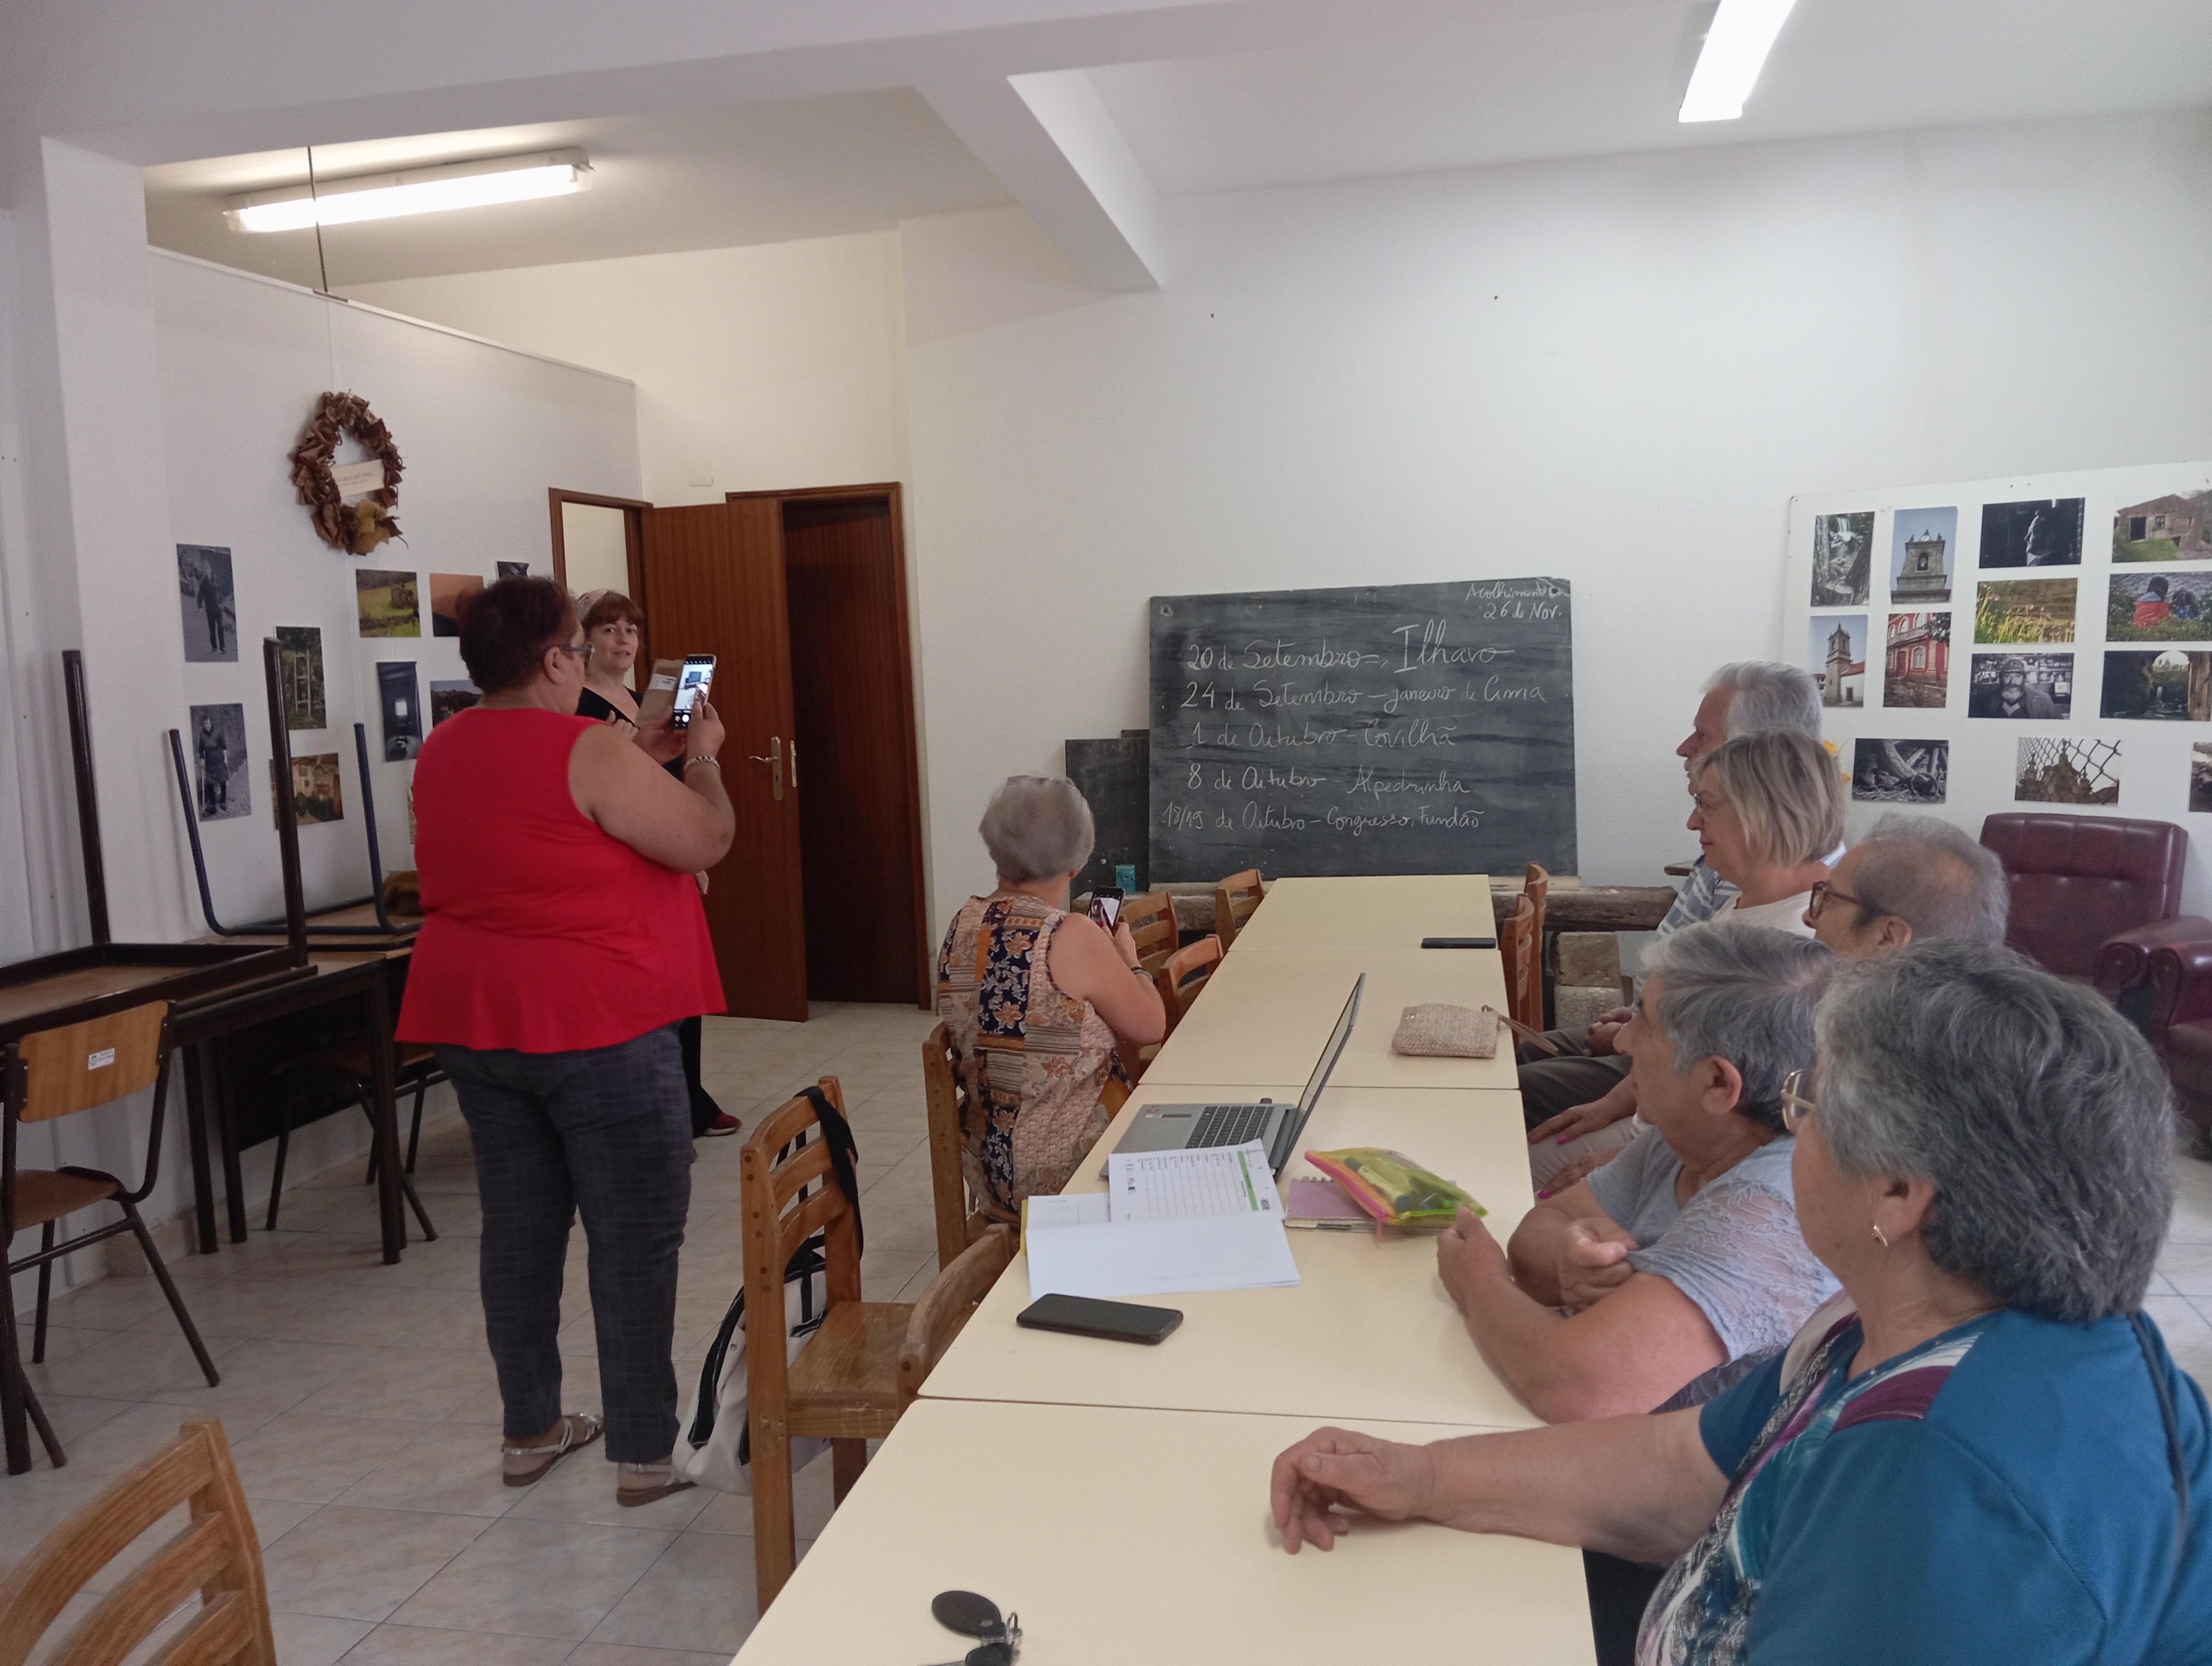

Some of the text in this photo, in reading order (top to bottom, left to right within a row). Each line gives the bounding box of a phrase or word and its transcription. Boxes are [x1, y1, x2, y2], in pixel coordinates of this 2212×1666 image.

[1483, 600, 1512, 619] 26
[1512, 600, 1524, 619] de
[1187, 644, 1214, 670] 20
[1218, 645, 1234, 670] de
[1243, 636, 1364, 668] Setembro
[1180, 681, 1214, 708] 24
[1225, 687, 1244, 710] de
[1253, 680, 1362, 707] Setembro
[1461, 681, 1477, 701] de
[1484, 675, 1547, 703] Cima
[1189, 721, 1207, 746] 1
[1217, 722, 1240, 746] de
[1249, 722, 1347, 747] Outubro
[1365, 717, 1457, 747] Covilhã
[1188, 762, 1202, 789] 8
[1214, 768, 1233, 790] de
[1162, 800, 1203, 831] 18/19
[1215, 808, 1234, 831] de
[1418, 805, 1484, 828] Fundão
